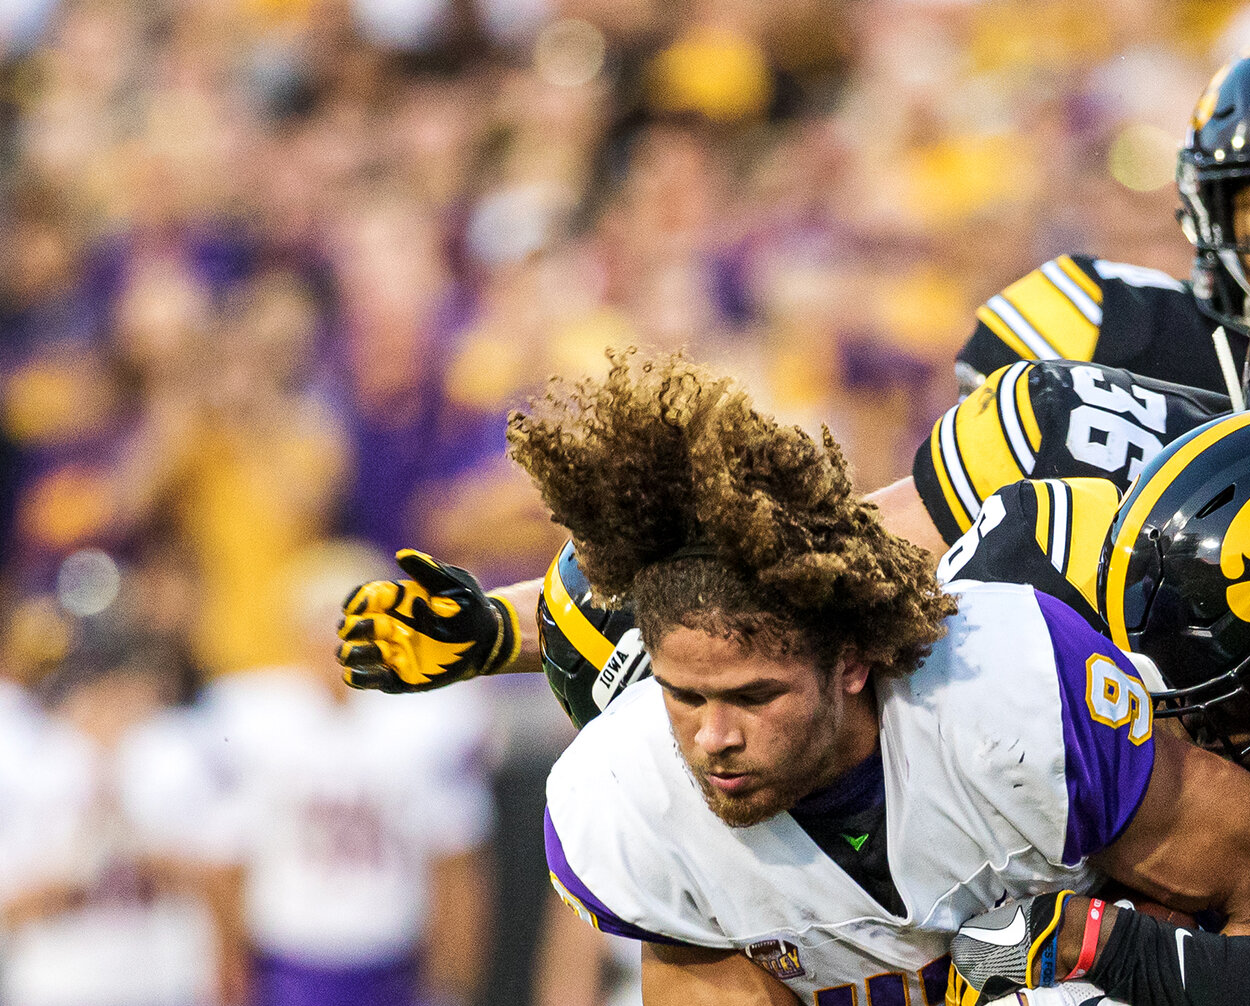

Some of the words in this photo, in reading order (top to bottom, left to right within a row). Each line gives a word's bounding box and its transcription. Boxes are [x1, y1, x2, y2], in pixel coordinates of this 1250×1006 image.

[1066, 366, 1168, 482] 36
[599, 650, 629, 689] IOWA
[1085, 652, 1154, 746] 9
